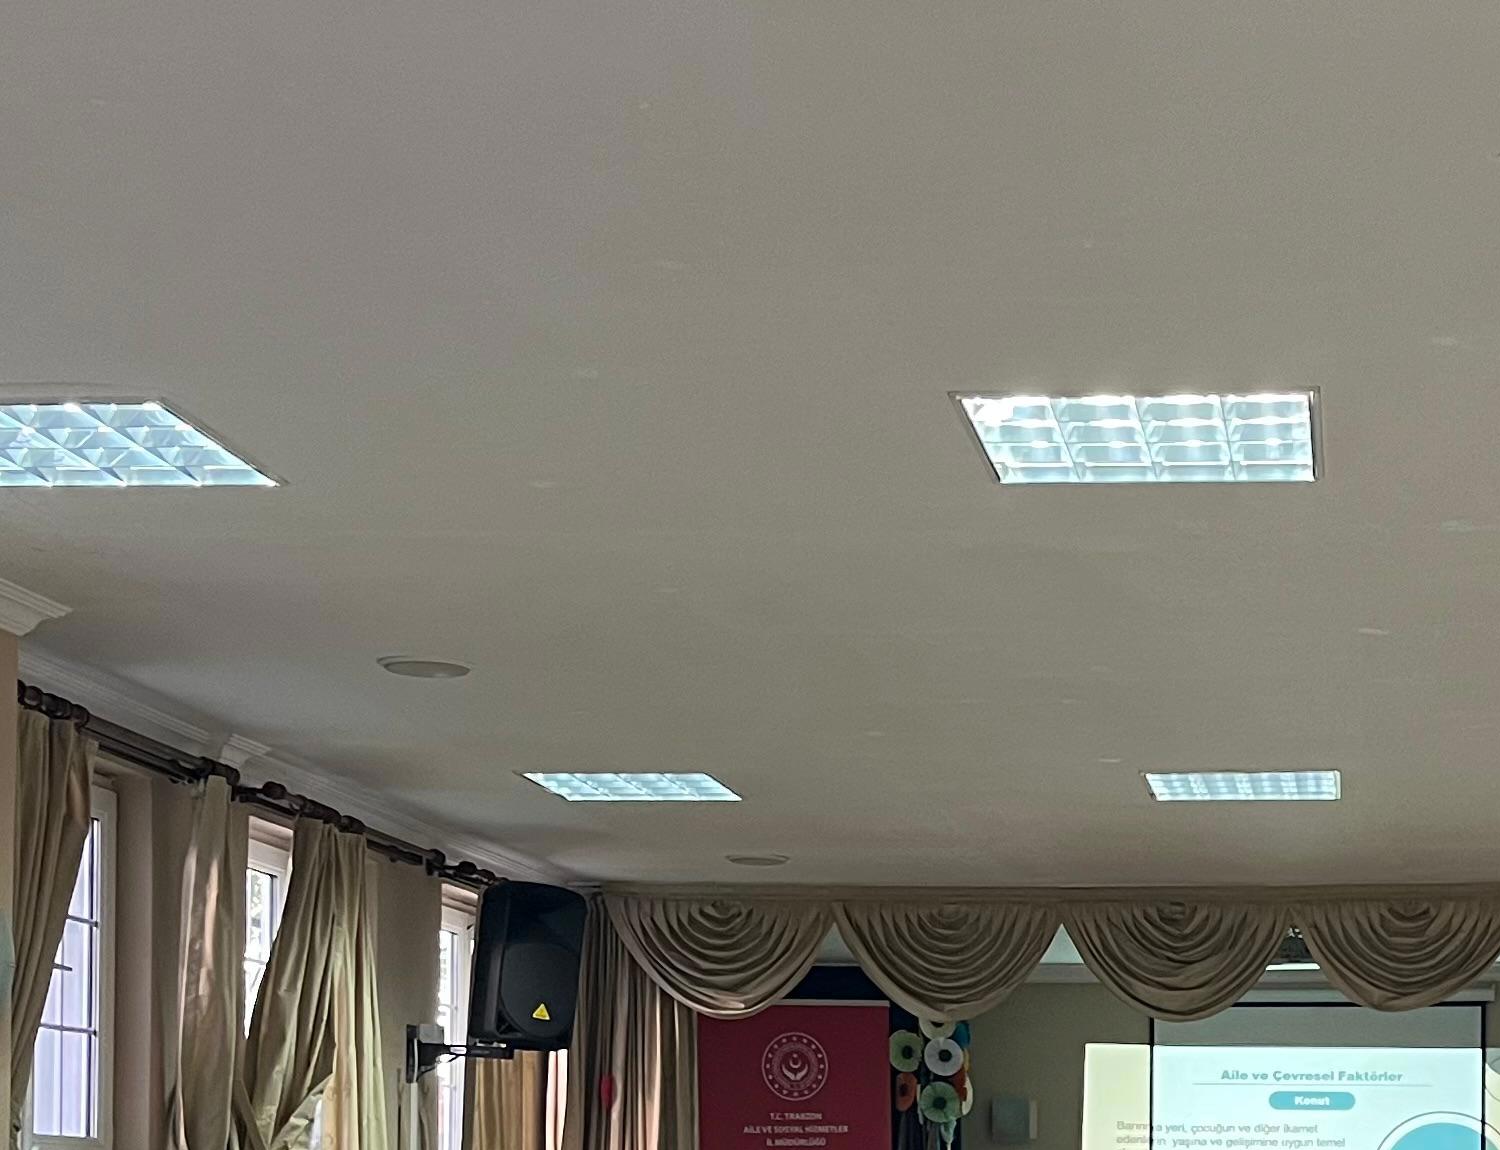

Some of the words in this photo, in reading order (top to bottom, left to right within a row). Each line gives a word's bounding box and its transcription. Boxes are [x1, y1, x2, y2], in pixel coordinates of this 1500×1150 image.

[1221, 1070, 1248, 1080] Aile
[1273, 1070, 1335, 1082] Çevresel
[1338, 1071, 1403, 1082] Faktörler
